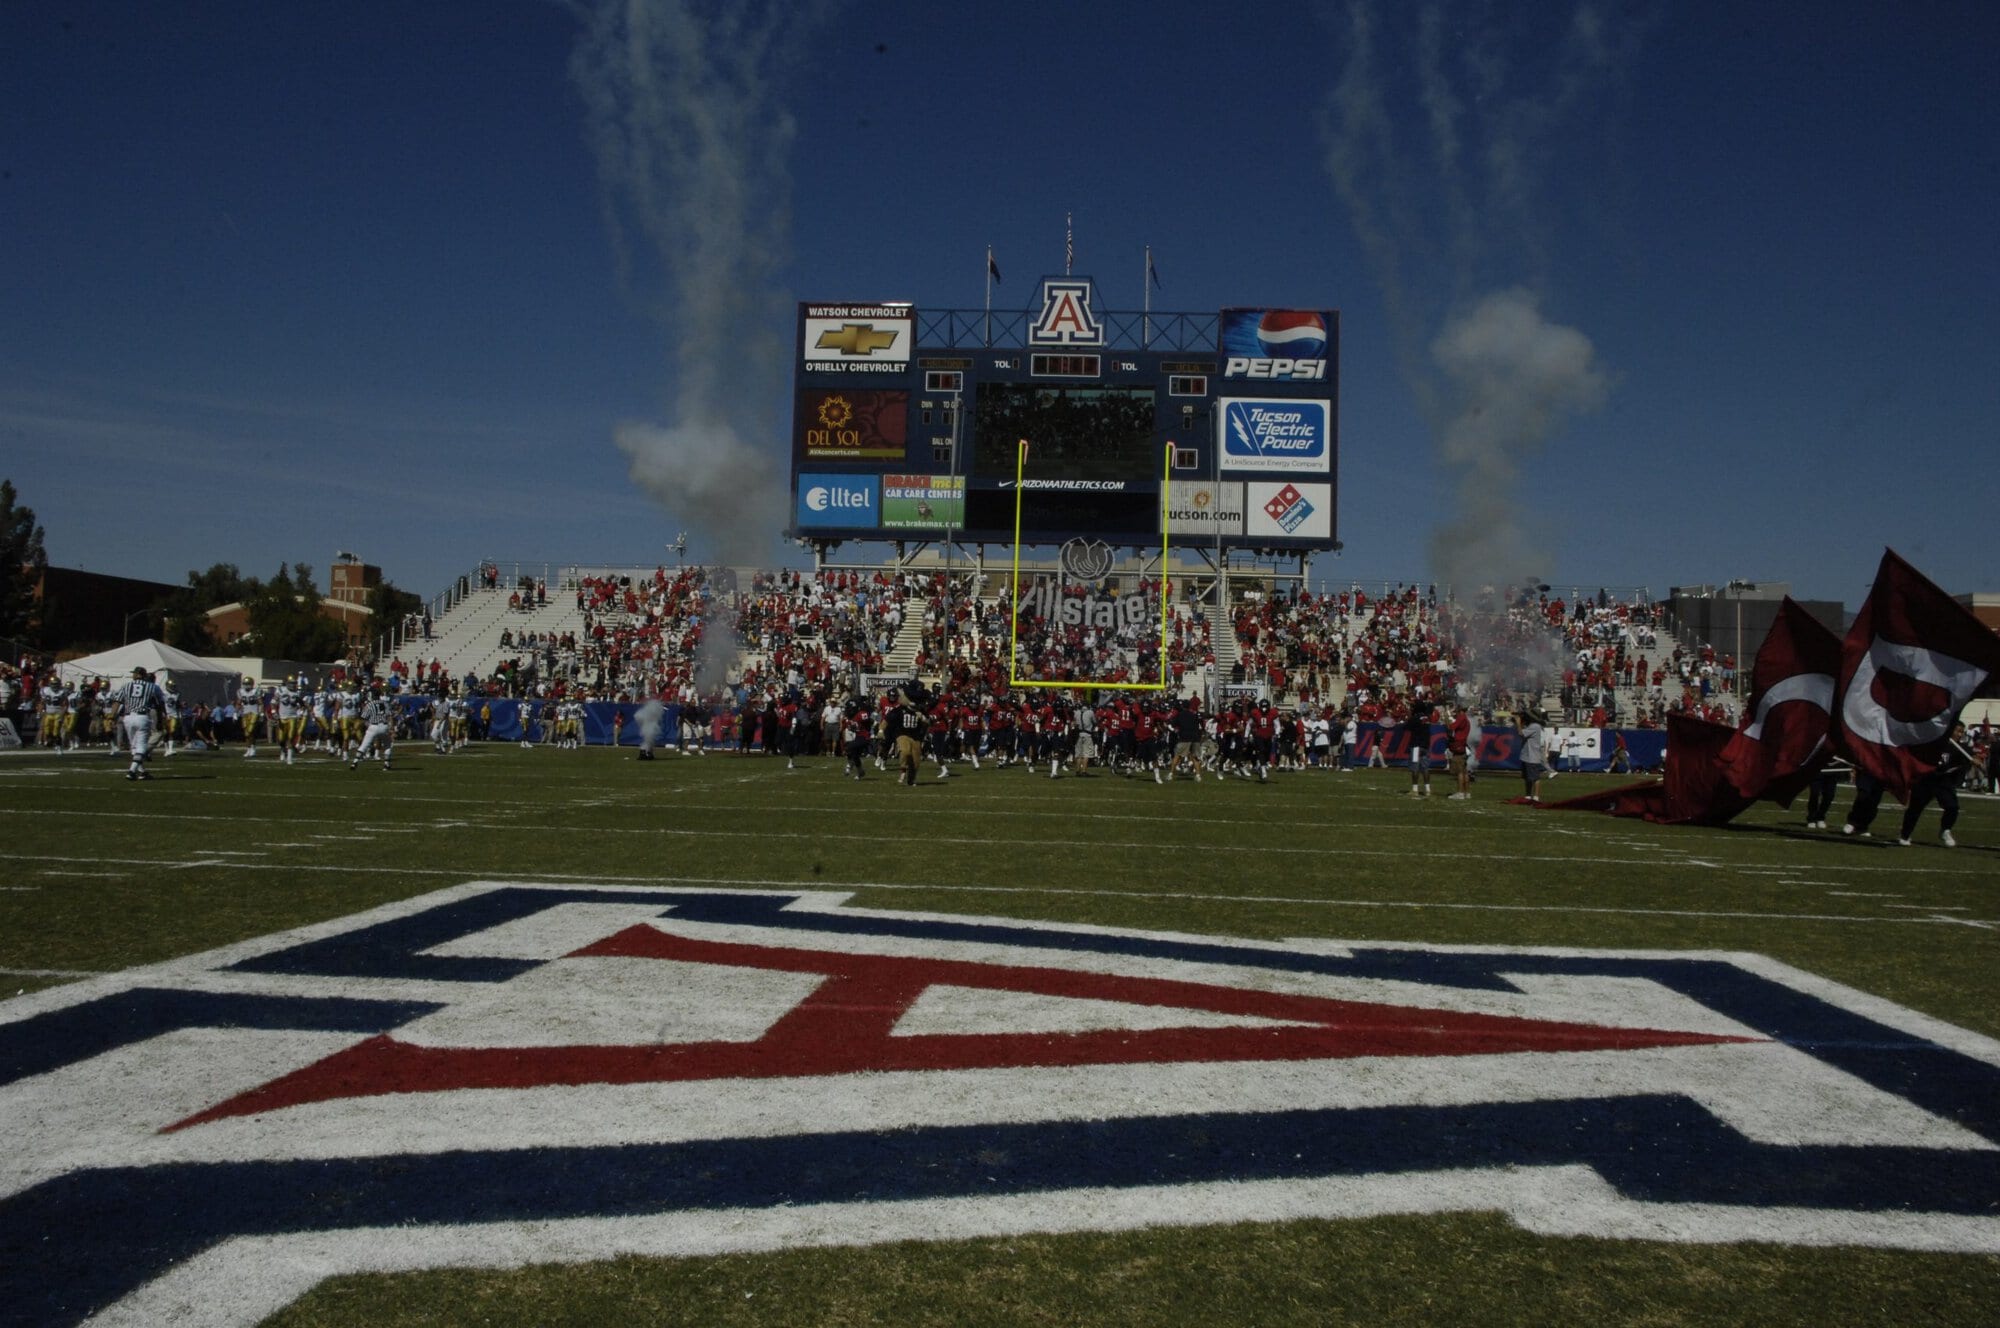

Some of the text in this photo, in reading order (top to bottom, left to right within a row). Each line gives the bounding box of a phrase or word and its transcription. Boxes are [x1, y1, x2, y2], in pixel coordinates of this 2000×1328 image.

[808, 307, 909, 317] WATSON CHEVROLET
[805, 362, 907, 373] O'RIELLY CHEVROLET
[994, 361, 1011, 369] TOL
[1121, 363, 1138, 371] TOL
[1224, 357, 1327, 379] PEPSI
[1250, 408, 1302, 423] Tucson
[1254, 422, 1316, 437] Electric
[807, 430, 862, 446] DEL SOL
[1260, 435, 1315, 450] Power
[1267, 459, 1290, 467] Energy
[1291, 460, 1323, 468] Company
[809, 487, 870, 508] alltel
[885, 489, 963, 499] CAR CARE CENTERS
[1164, 510, 1241, 521] ucson.com
